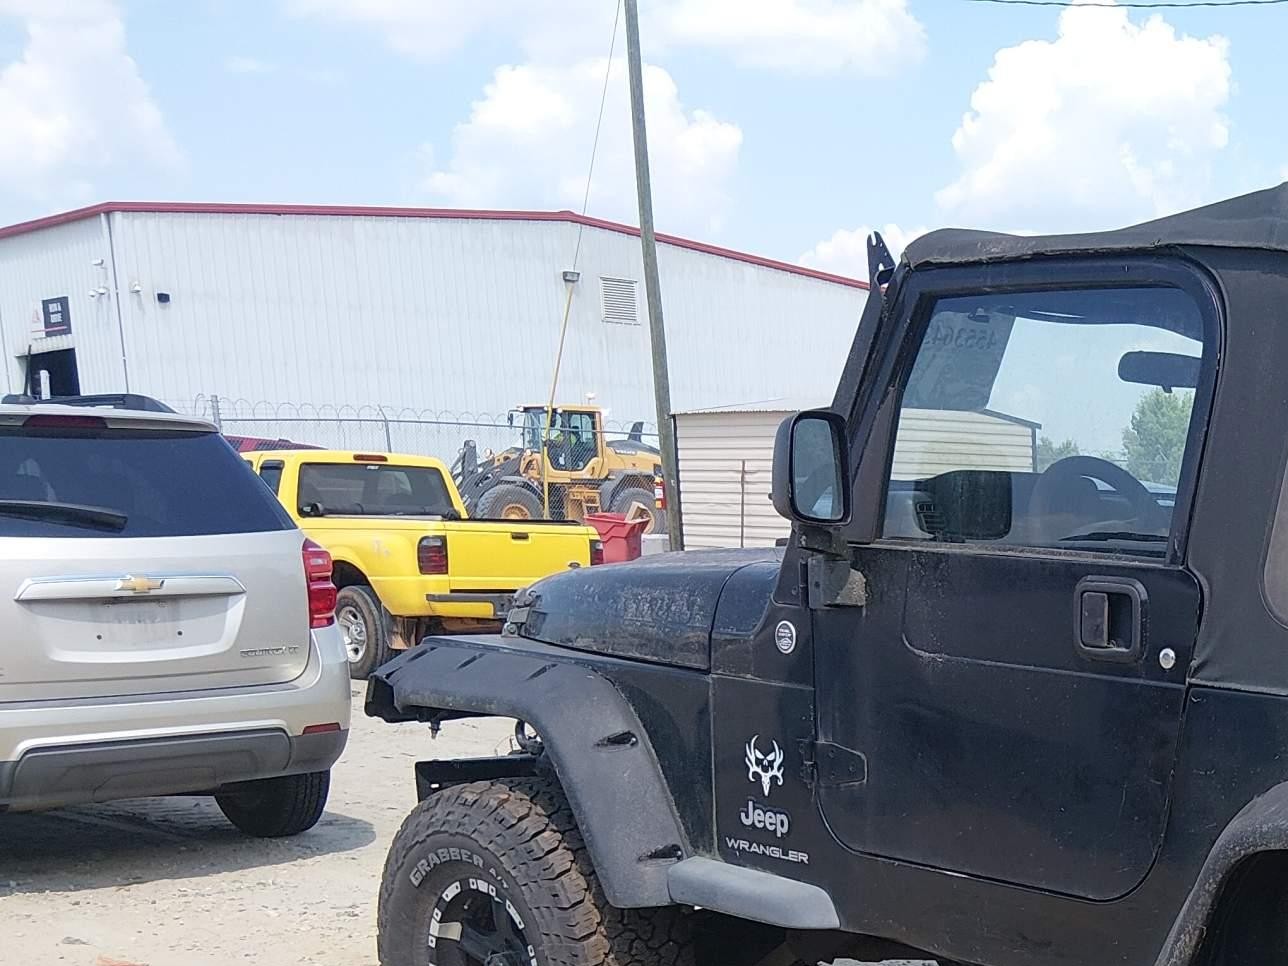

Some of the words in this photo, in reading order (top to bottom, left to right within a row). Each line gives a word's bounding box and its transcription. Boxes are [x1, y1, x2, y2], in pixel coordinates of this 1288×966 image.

[740, 800, 789, 838] Jeep
[409, 847, 484, 888] GRABBER
[725, 836, 809, 864] WRANGLER
